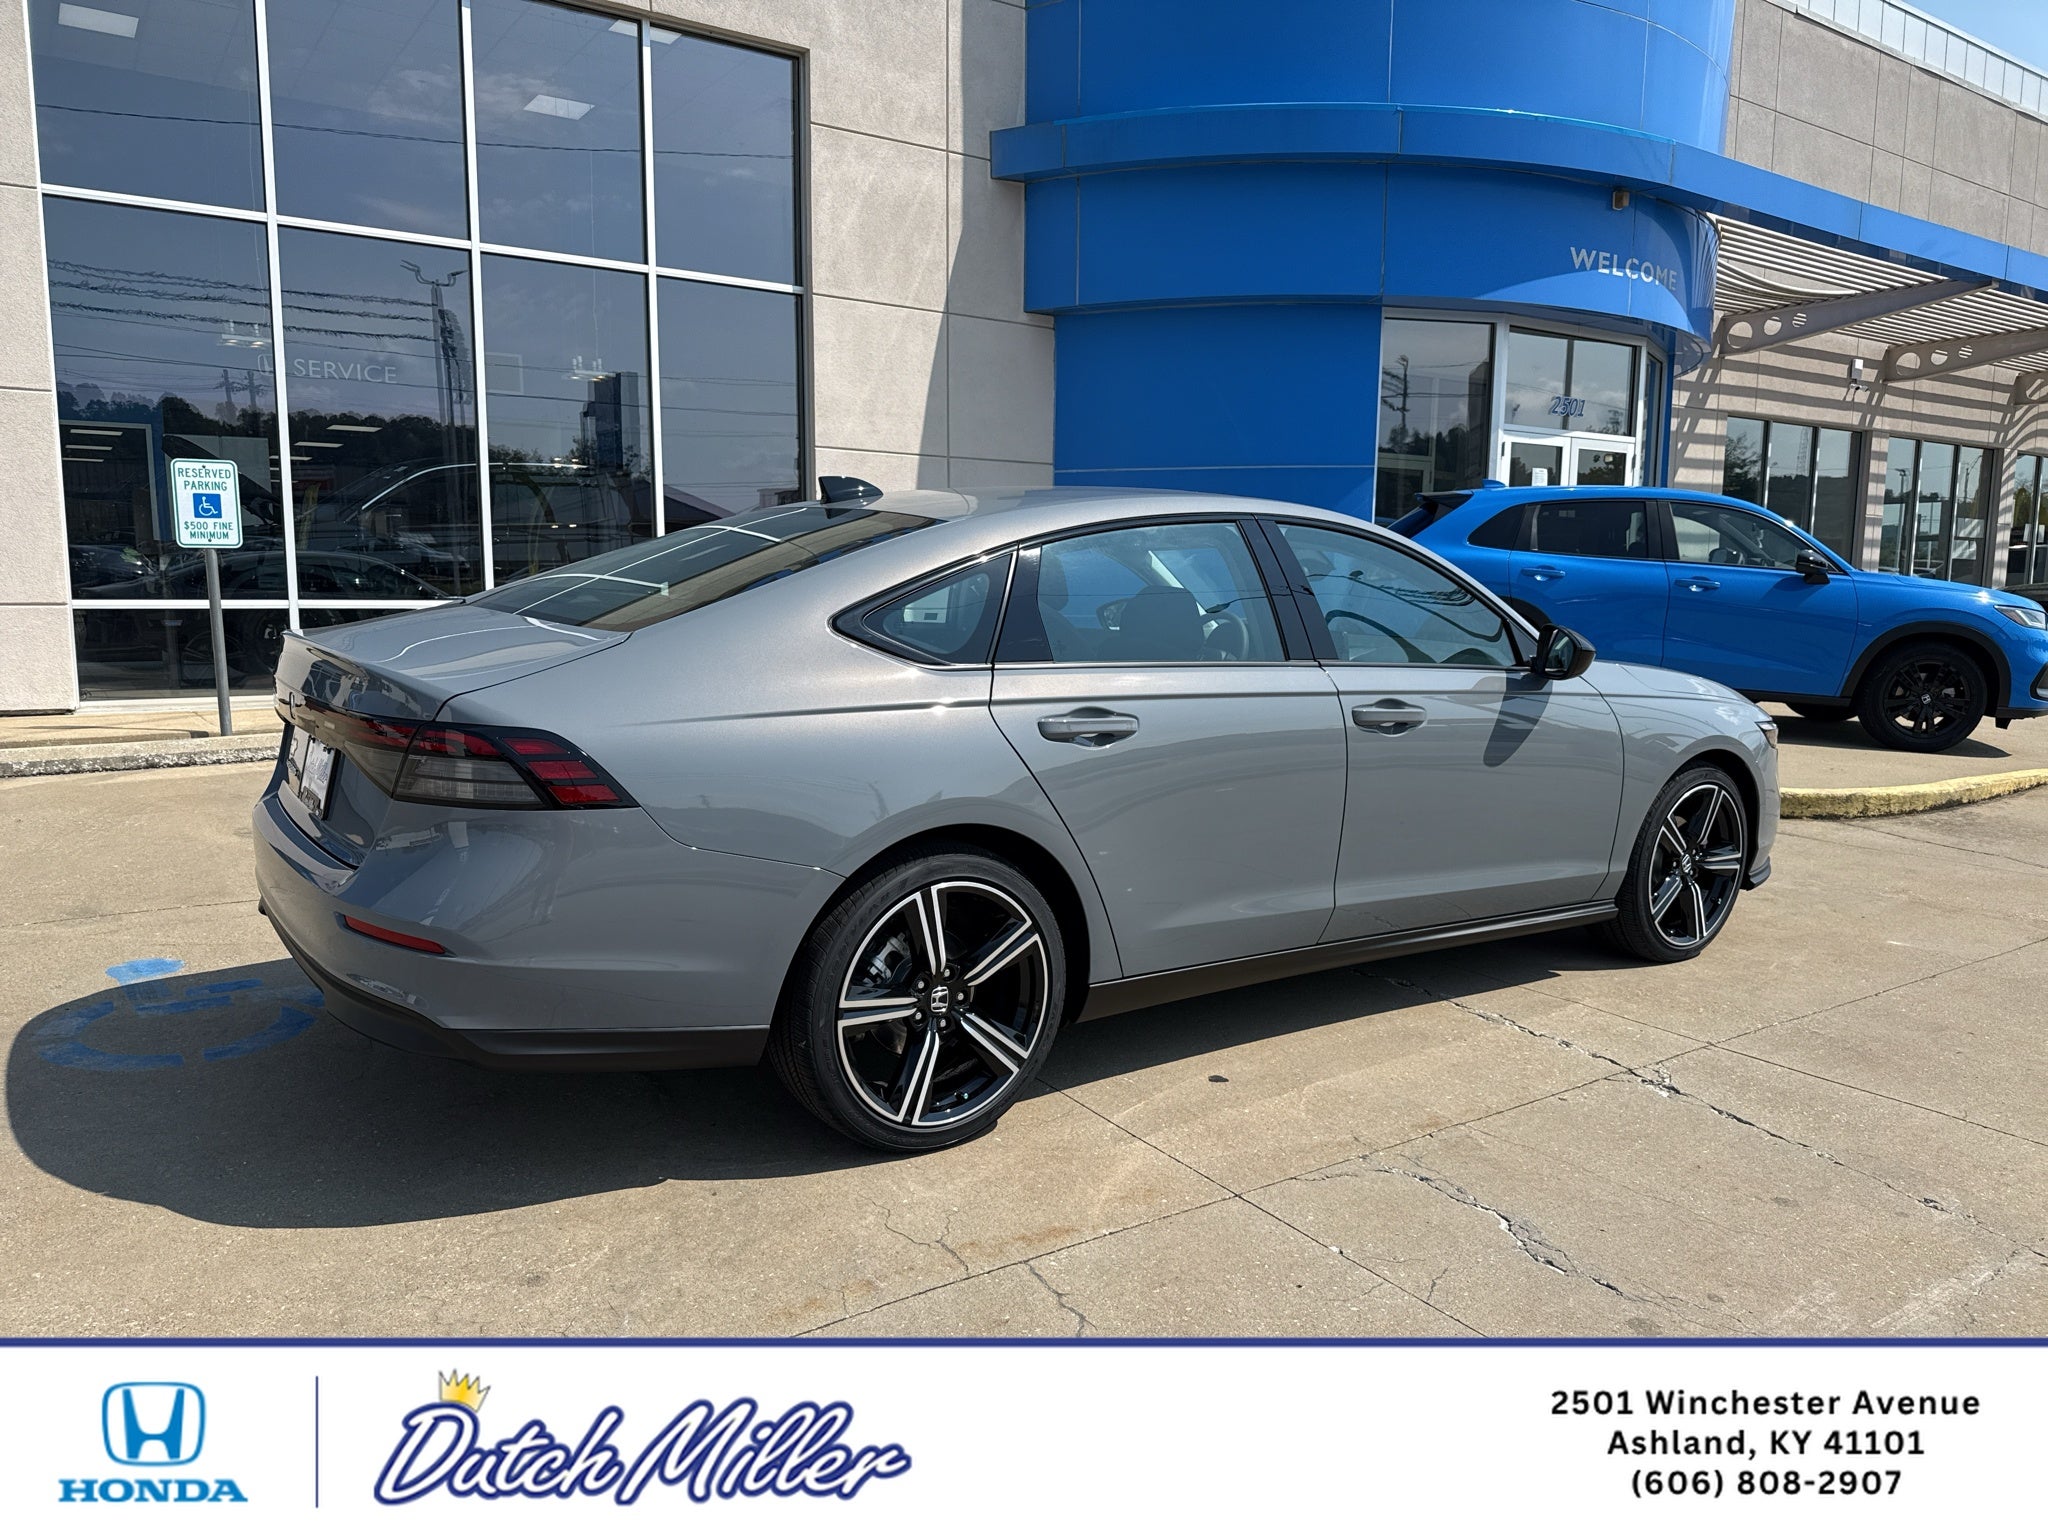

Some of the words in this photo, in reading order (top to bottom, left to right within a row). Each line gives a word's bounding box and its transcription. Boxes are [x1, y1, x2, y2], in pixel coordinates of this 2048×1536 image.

[1570, 246, 1678, 291] WELCOME
[293, 358, 398, 384] SERVICE
[1550, 396, 1586, 417] 2501
[177, 467, 232, 479] RESERVED
[183, 480, 228, 491] PARKING
[183, 521, 209, 530] $500
[213, 521, 234, 531] FINE
[189, 531, 230, 540] MINIMUM
